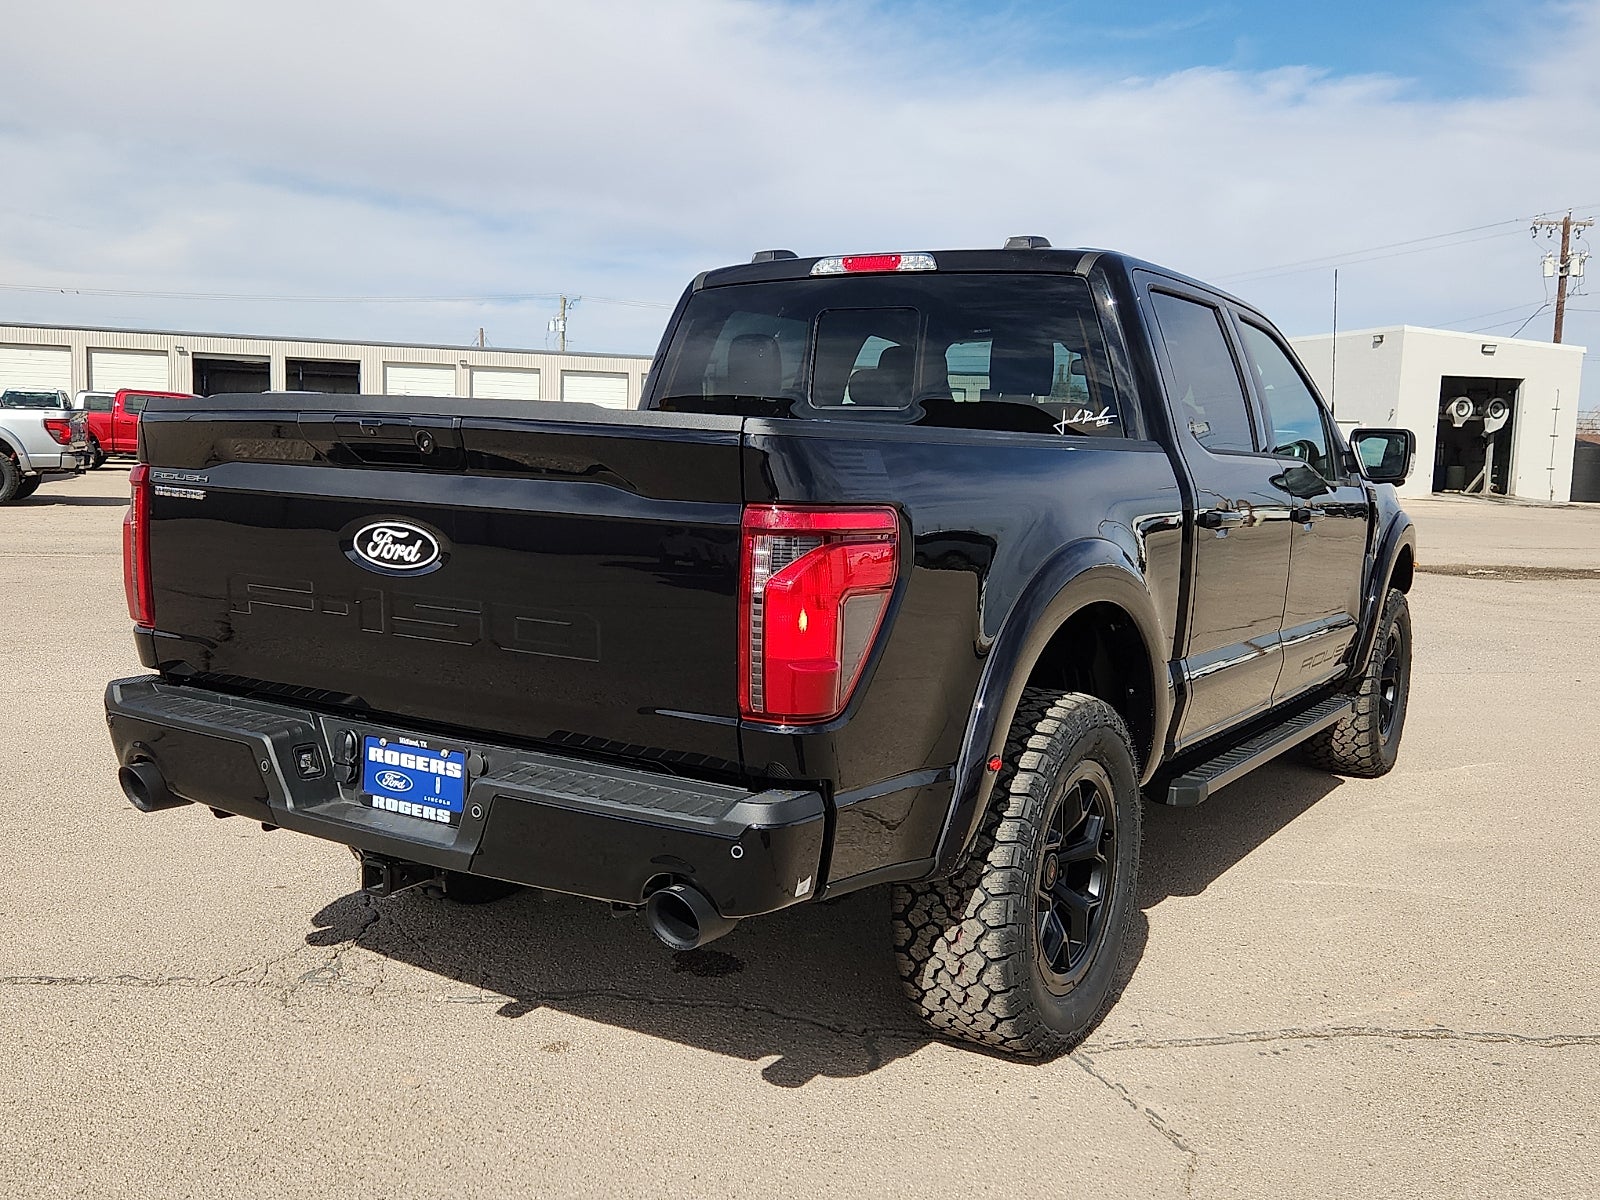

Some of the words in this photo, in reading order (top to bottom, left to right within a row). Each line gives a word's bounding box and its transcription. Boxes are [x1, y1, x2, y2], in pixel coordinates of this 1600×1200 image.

[153, 471, 209, 483] ROUSH
[366, 526, 423, 564] Ford
[227, 572, 601, 664] F-150
[1299, 642, 1348, 674] ROUS
[368, 746, 462, 779] ROGERS
[381, 772, 406, 790] Ford
[372, 794, 451, 824] ROGERS
[423, 795, 451, 806] LINCOLN
